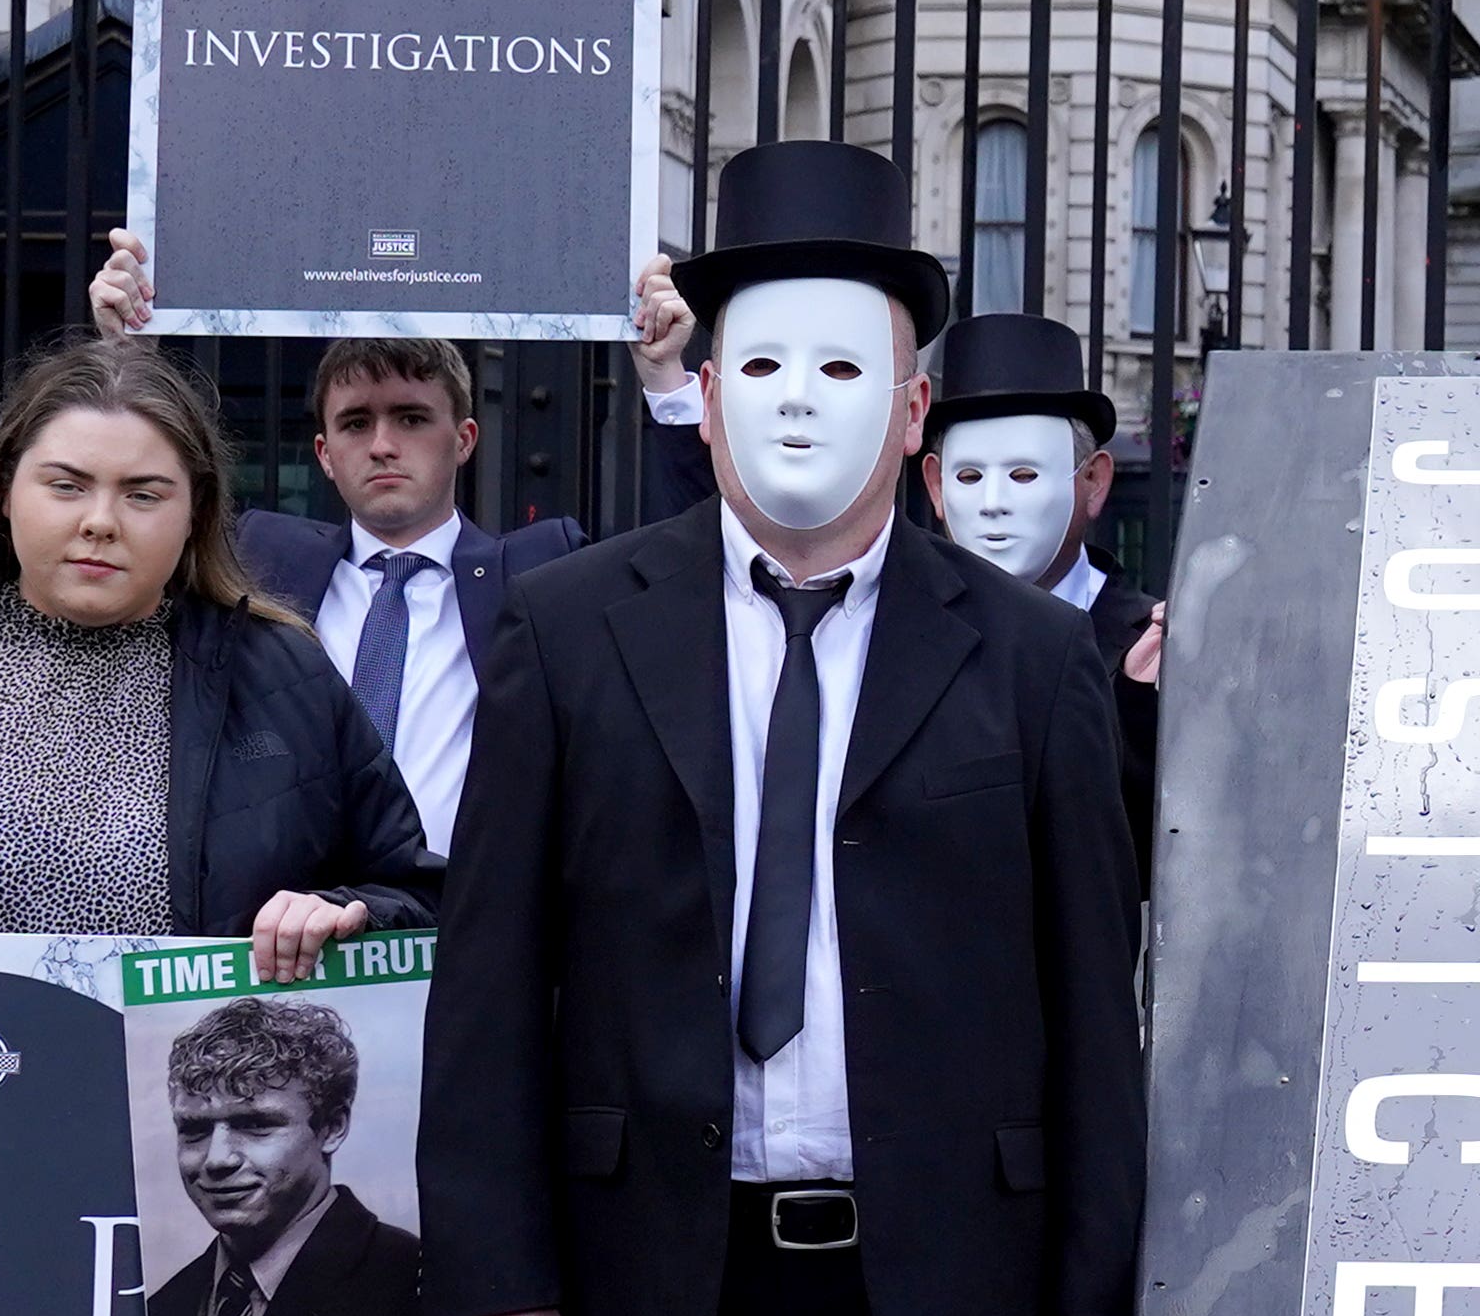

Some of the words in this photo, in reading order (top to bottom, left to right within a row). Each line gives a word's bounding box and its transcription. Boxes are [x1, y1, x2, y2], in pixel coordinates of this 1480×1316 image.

[185, 29, 612, 75] INVESTIGATIONS
[372, 242, 415, 252] JUSTICE
[303, 269, 482, 285] www.relativesforjustice.com
[135, 951, 236, 996] TIME
